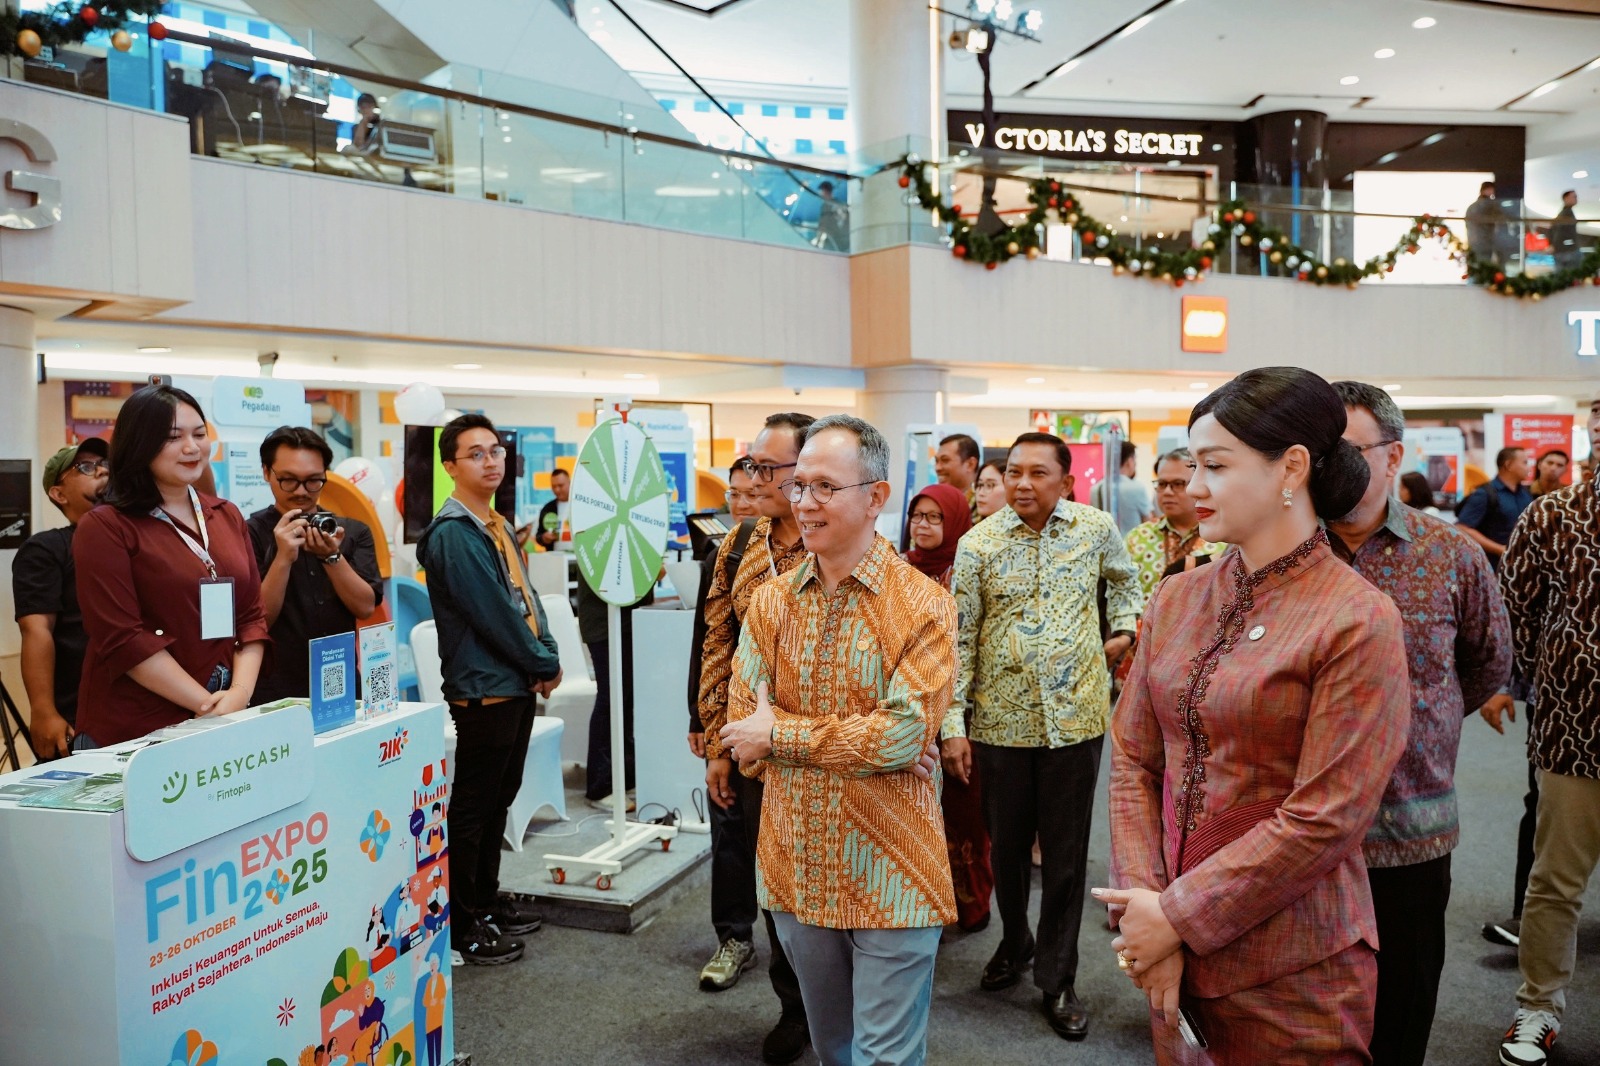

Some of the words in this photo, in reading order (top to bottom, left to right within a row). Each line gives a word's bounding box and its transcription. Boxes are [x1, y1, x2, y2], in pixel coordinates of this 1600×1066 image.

[965, 123, 1106, 152] VCTORIA'S
[1114, 130, 1203, 155] SECRET
[242, 400, 280, 413] Pegadaian
[575, 493, 590, 505] KIPAS
[590, 498, 615, 513] PORTABLE
[321, 647, 345, 656] Pendanaan
[196, 743, 290, 787] EASYCASH
[216, 782, 252, 801] Fintopia
[240, 811, 329, 877] EXPO
[145, 858, 238, 943] Fin
[150, 944, 181, 968] 23-26
[183, 916, 236, 950] OKTOBER
[151, 964, 193, 996] Inklusi
[196, 936, 251, 972] Keuangan
[253, 918, 283, 941] Untuk
[285, 901, 320, 925] Semua,
[152, 982, 195, 1015] Rakyat
[255, 926, 303, 958] Indonesia
[306, 911, 328, 932] Maju
